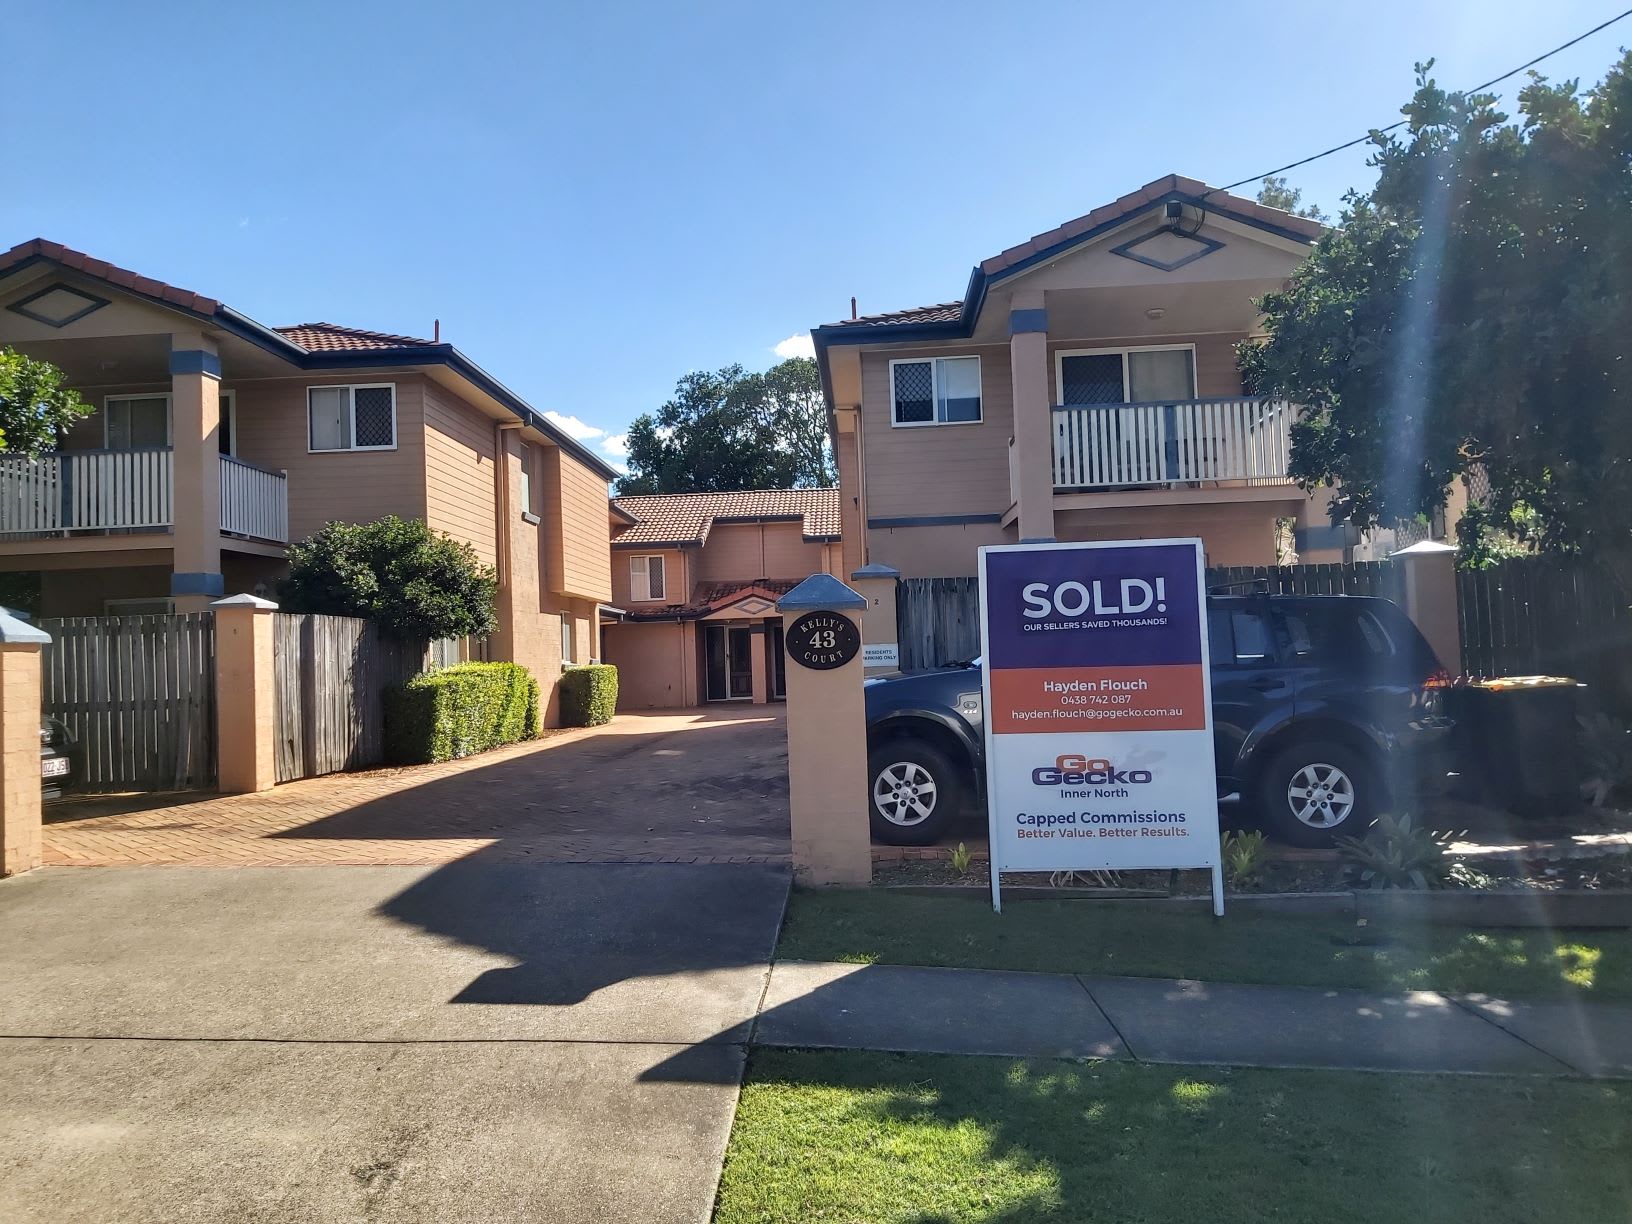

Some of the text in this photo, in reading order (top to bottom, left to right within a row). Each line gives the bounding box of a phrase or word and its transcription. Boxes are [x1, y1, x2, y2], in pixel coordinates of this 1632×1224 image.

[1022, 577, 1167, 619] SOLD!
[801, 619, 844, 632] KELLY'S
[1023, 617, 1168, 631] OUR SELLERS SAVED THOUSANDS!
[809, 631, 836, 648] 43
[804, 650, 844, 663] COURT
[1043, 678, 1148, 694] Hayden Flouch
[1061, 694, 1132, 705] 0438 742 087
[1011, 707, 1183, 720] hayden.flouch@gogecko.com.au
[1055, 754, 1111, 773] Go
[1031, 766, 1153, 786] Gecko
[1060, 788, 1129, 798] Inner North
[1016, 810, 1186, 828] Capped Commissions
[1017, 826, 1190, 839] Better Value. Better Results.
